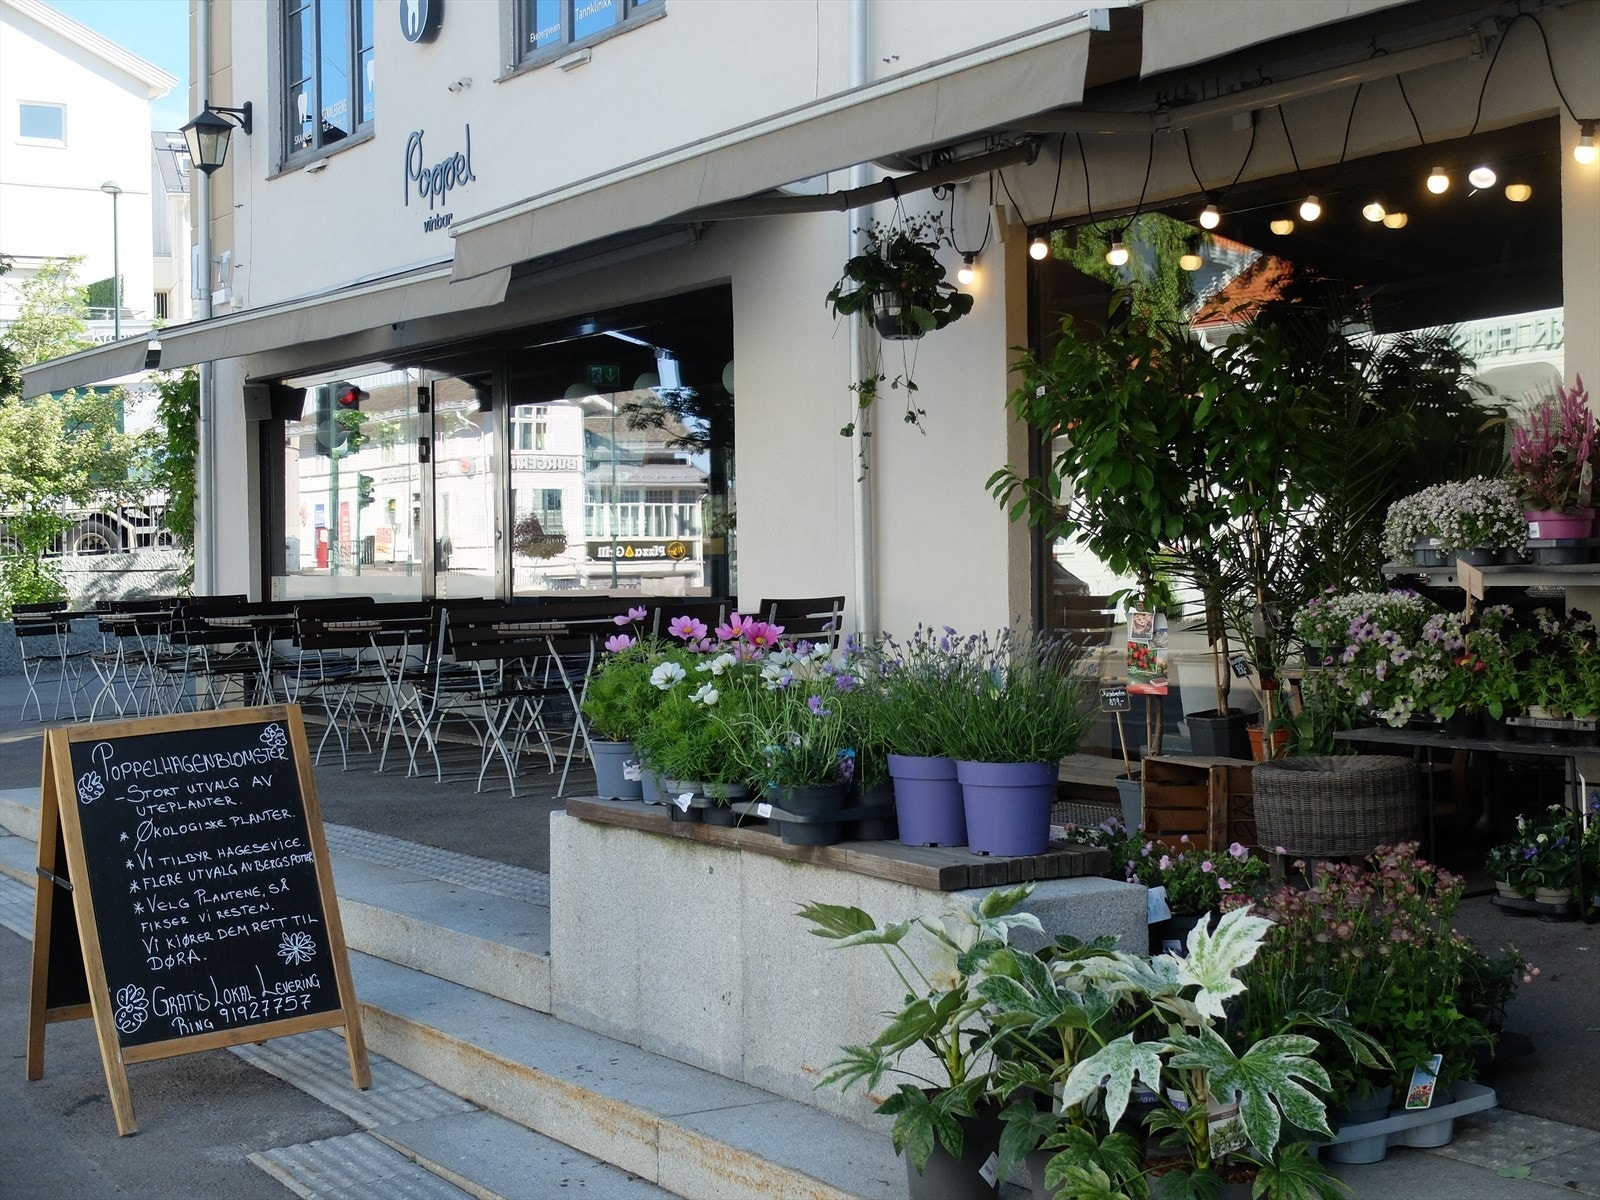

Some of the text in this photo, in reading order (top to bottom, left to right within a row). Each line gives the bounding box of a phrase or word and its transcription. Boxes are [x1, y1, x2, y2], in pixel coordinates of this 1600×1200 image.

[530, 23, 560, 43] Ekebergveien
[404, 123, 476, 210] Poppel
[424, 213, 453, 233] vinbar
[187, 777, 240, 795] UTVALG
[252, 774, 273, 788] AV
[159, 851, 212, 866] TILBYR
[143, 874, 184, 891] FLERE
[188, 863, 239, 882] UTVALG
[241, 862, 253, 873] AV
[147, 893, 190, 913] VELG
[268, 878, 290, 895] SÅ
[141, 915, 190, 933] FIKSER
[217, 924, 250, 940] DEM
[251, 916, 288, 932] RETT
[291, 913, 319, 928] TIL
[209, 975, 257, 1007] LOKAL
[219, 994, 312, 1023] 91927757
